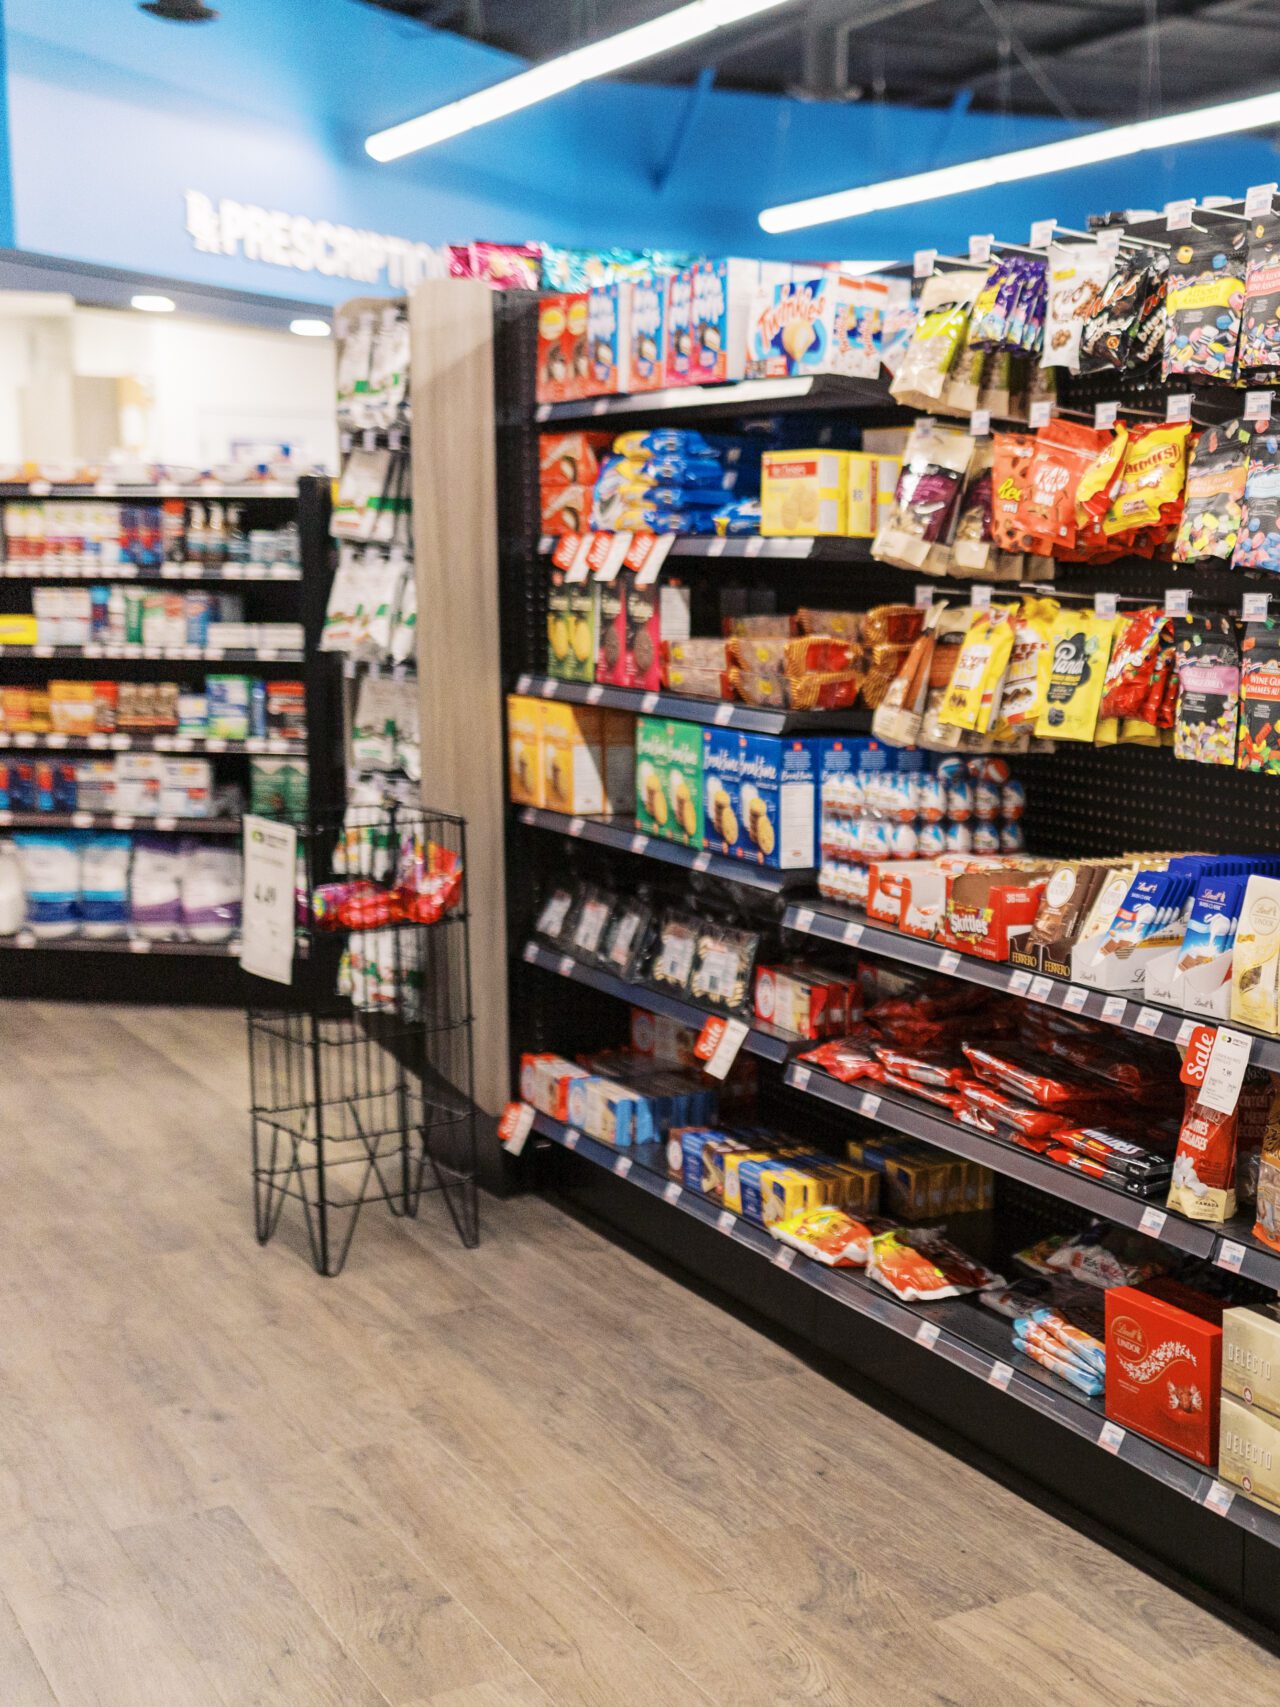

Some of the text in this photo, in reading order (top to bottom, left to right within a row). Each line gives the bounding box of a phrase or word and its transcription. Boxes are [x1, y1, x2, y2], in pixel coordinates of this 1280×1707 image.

[1250, 676, 1268, 686] WINE
[950, 913, 989, 937] Skittles
[1011, 951, 1038, 968] FERRERO
[1044, 960, 1071, 977] FERRERO
[1186, 1032, 1215, 1081] Sale
[1228, 1343, 1272, 1381] DELECTO
